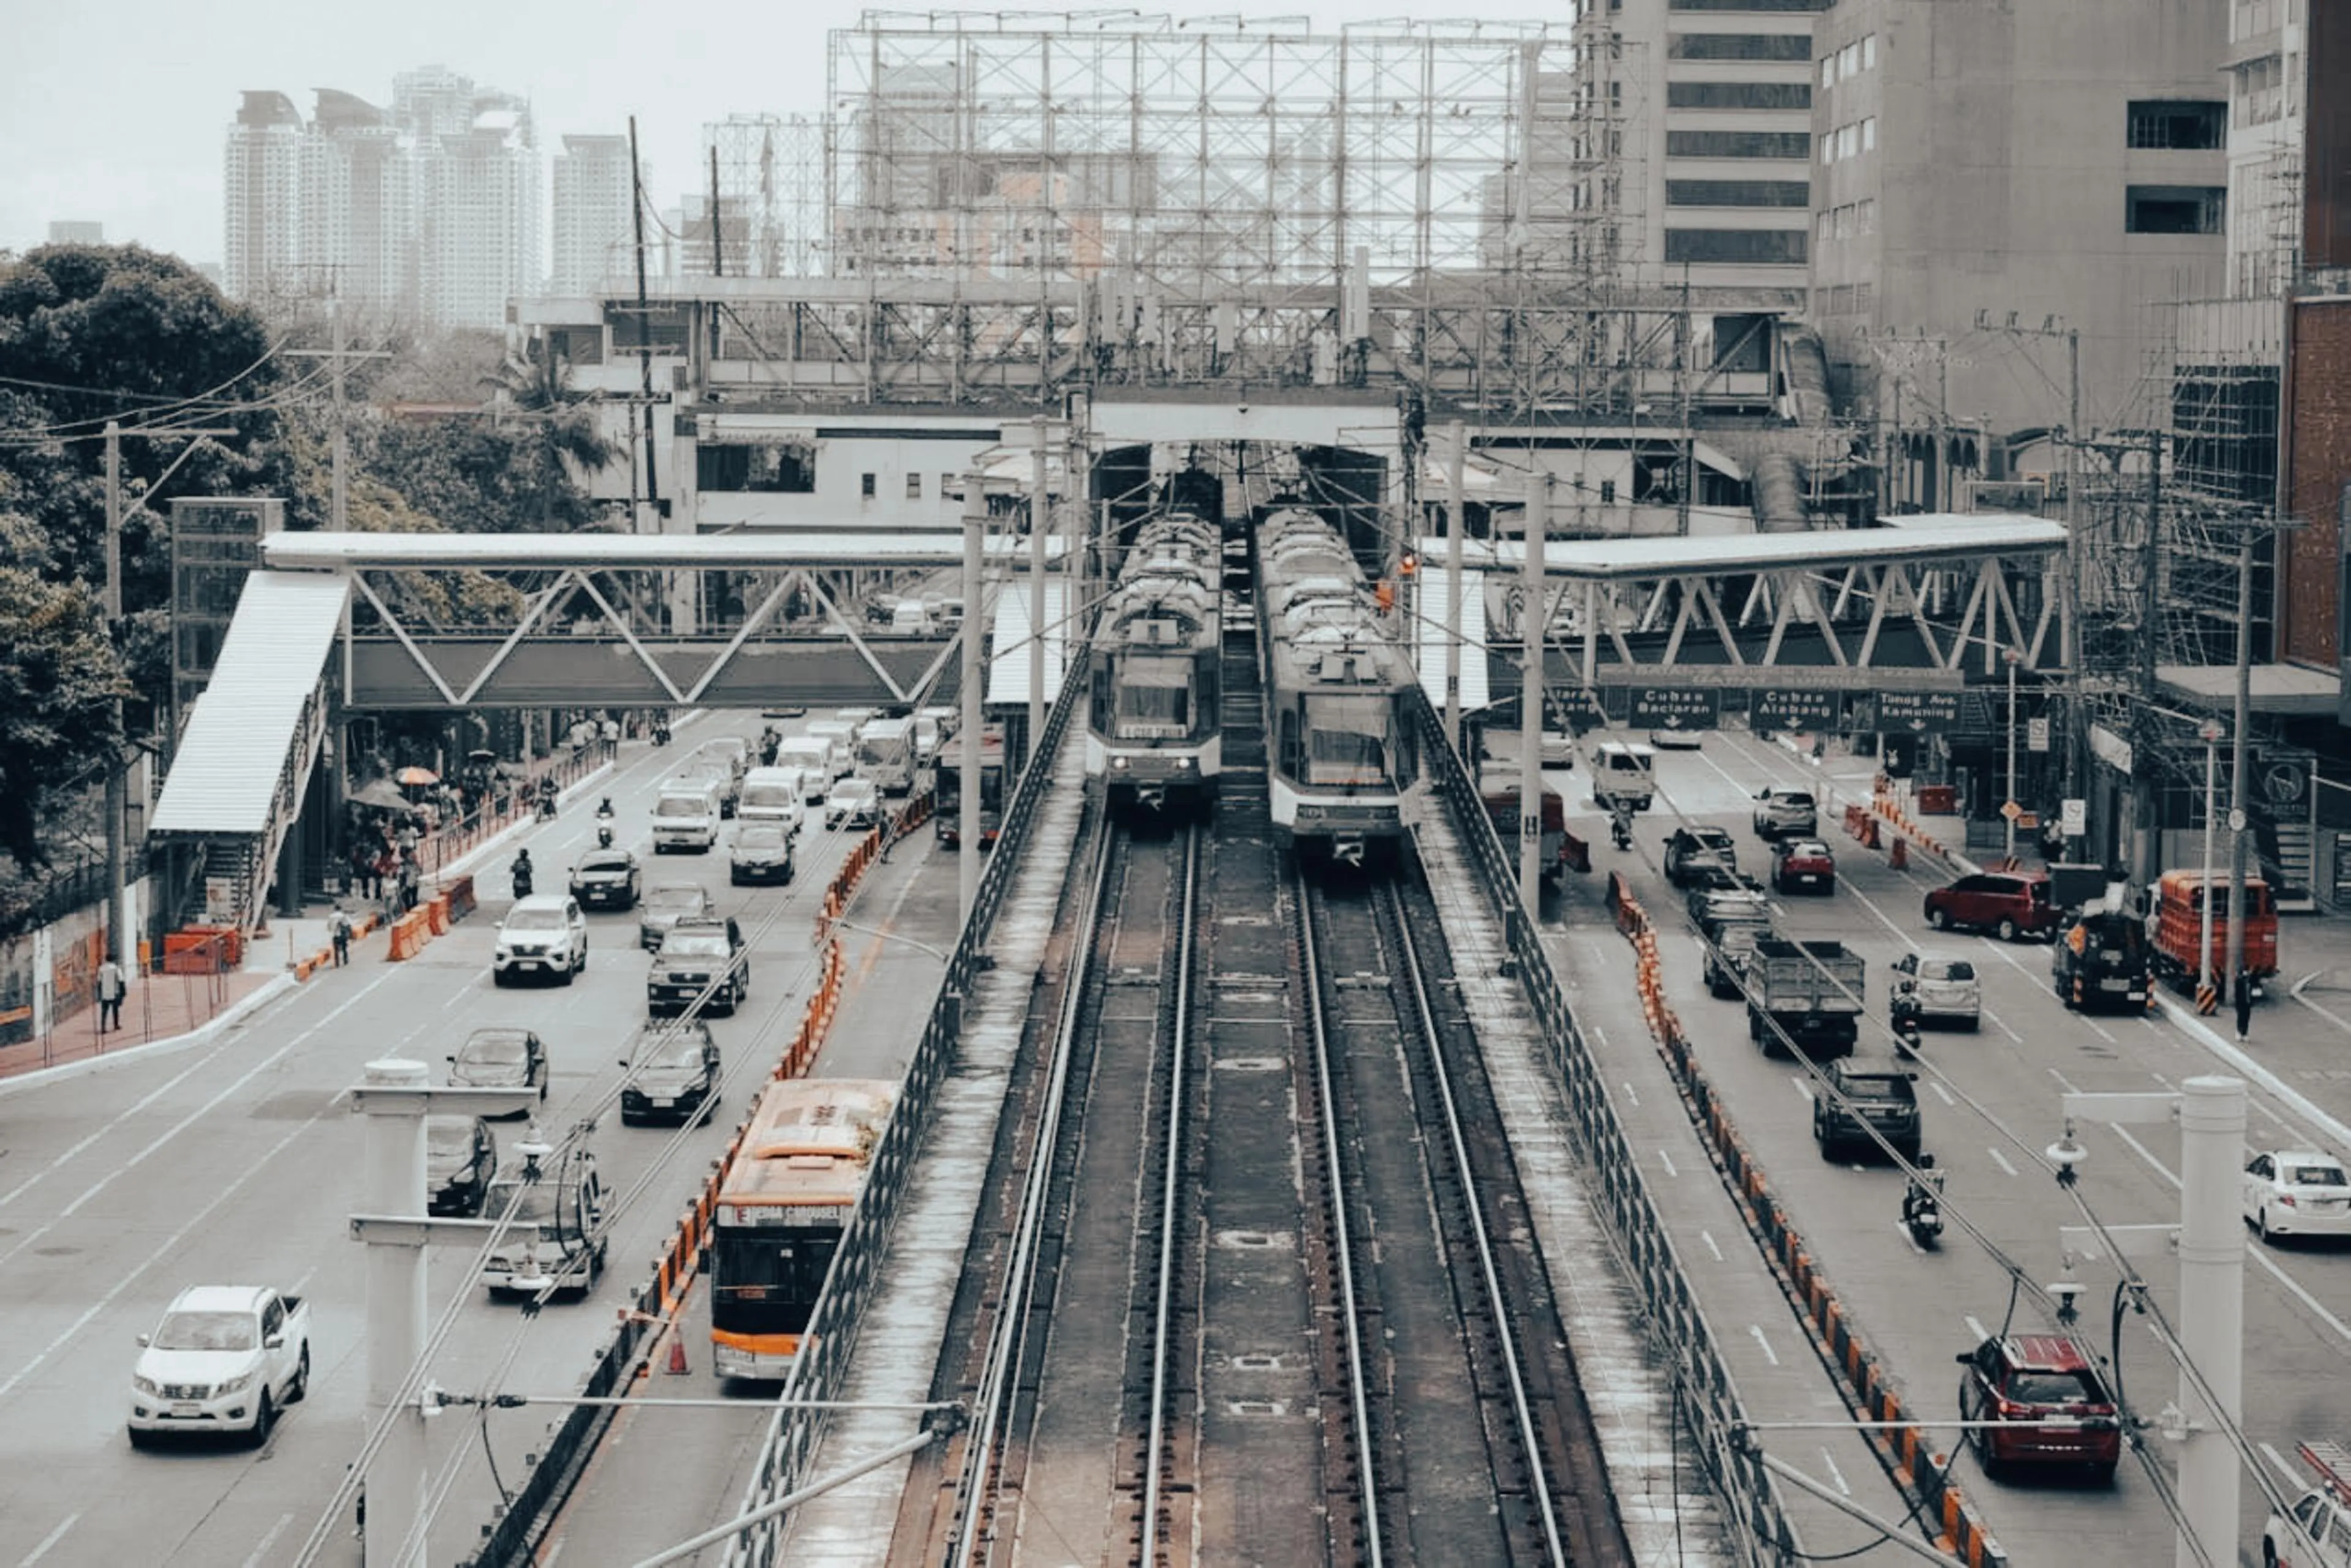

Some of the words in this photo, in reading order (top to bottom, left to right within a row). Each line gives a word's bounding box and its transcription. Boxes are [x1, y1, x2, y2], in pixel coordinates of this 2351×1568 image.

[1645, 691, 1704, 702] Cubao
[1766, 692, 1824, 702] Cubao
[1880, 692, 1921, 707] Timog
[1929, 694, 1957, 705] Ave.
[1637, 702, 1710, 714] Baclaran
[1759, 703, 1831, 717] Alabang
[1881, 705, 1955, 719] Kamuning
